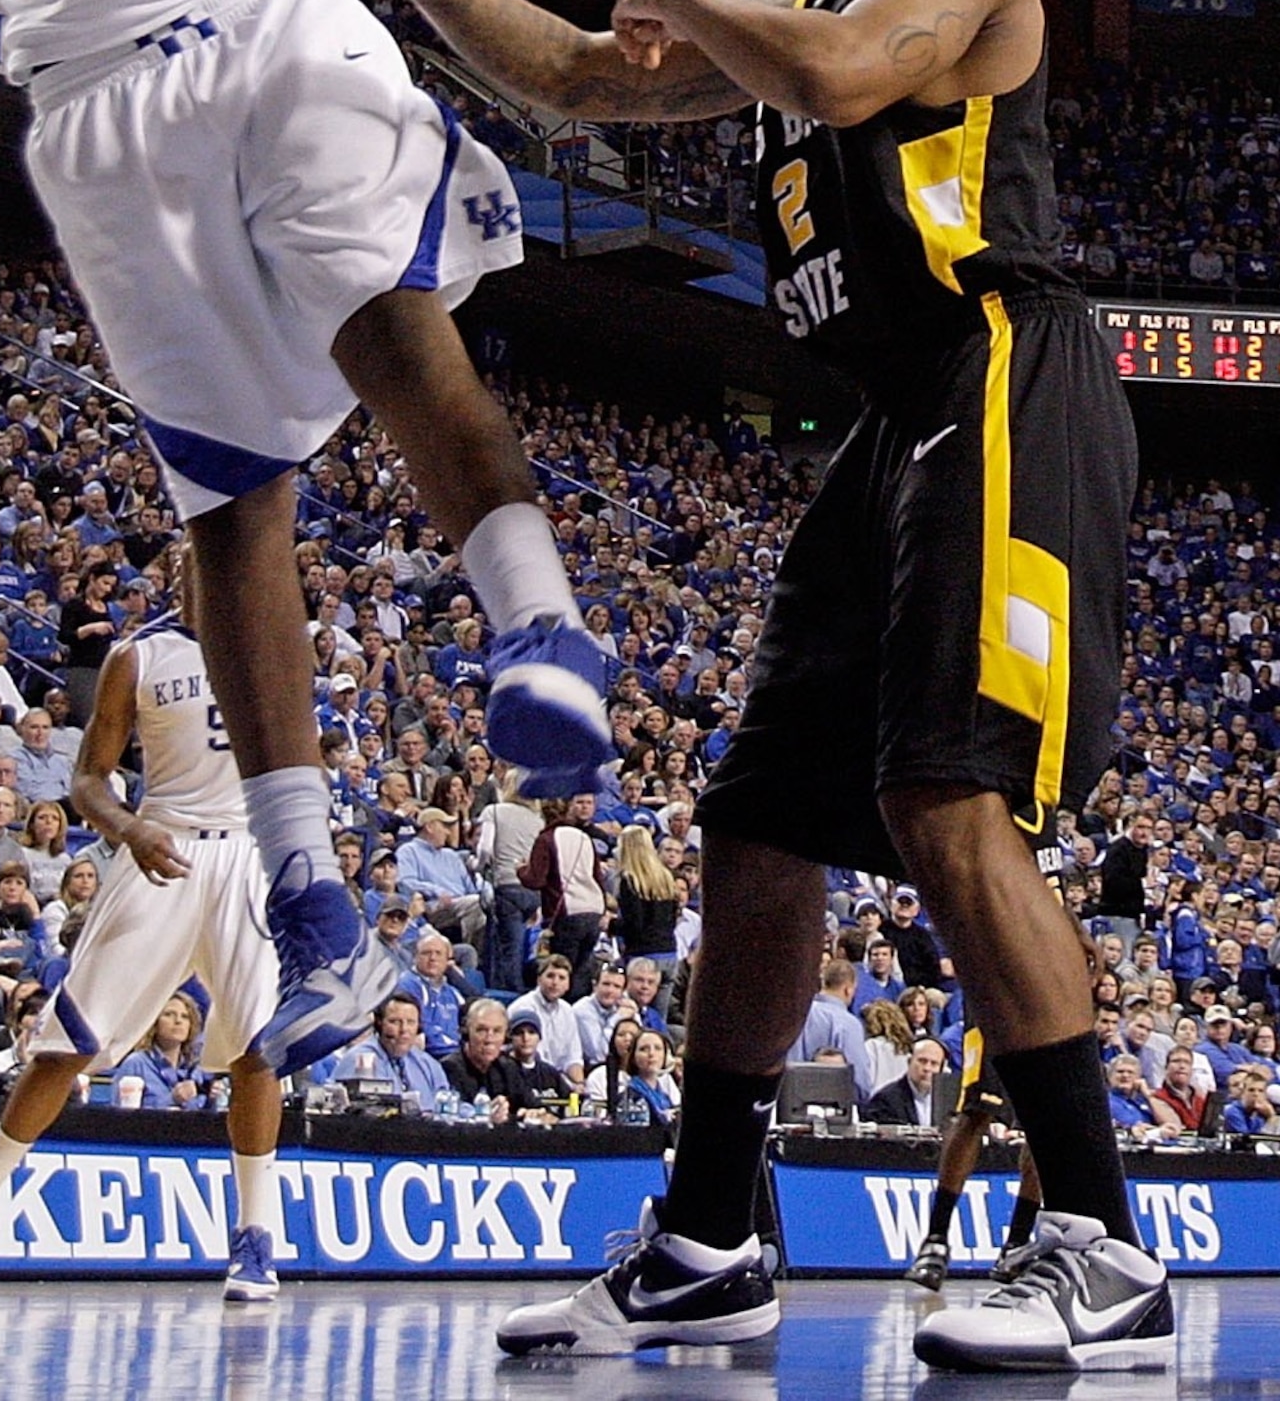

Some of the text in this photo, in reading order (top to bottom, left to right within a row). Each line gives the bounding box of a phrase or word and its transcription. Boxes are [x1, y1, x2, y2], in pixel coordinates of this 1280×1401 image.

[461, 188, 521, 243] UK
[772, 156, 816, 257] 2
[1107, 312, 1191, 330] PLY FLS PTS
[1211, 318, 1234, 333] PLY
[1242, 319, 1266, 334] FLS
[1142, 330, 1159, 354] 2
[1176, 331, 1194, 355] 5
[1212, 335, 1240, 356] 11
[1245, 335, 1262, 358] 2
[1116, 351, 1194, 379] 5 1 5
[1245, 358, 1262, 381] 2
[153, 674, 214, 707] KEN
[207, 703, 232, 752] 5
